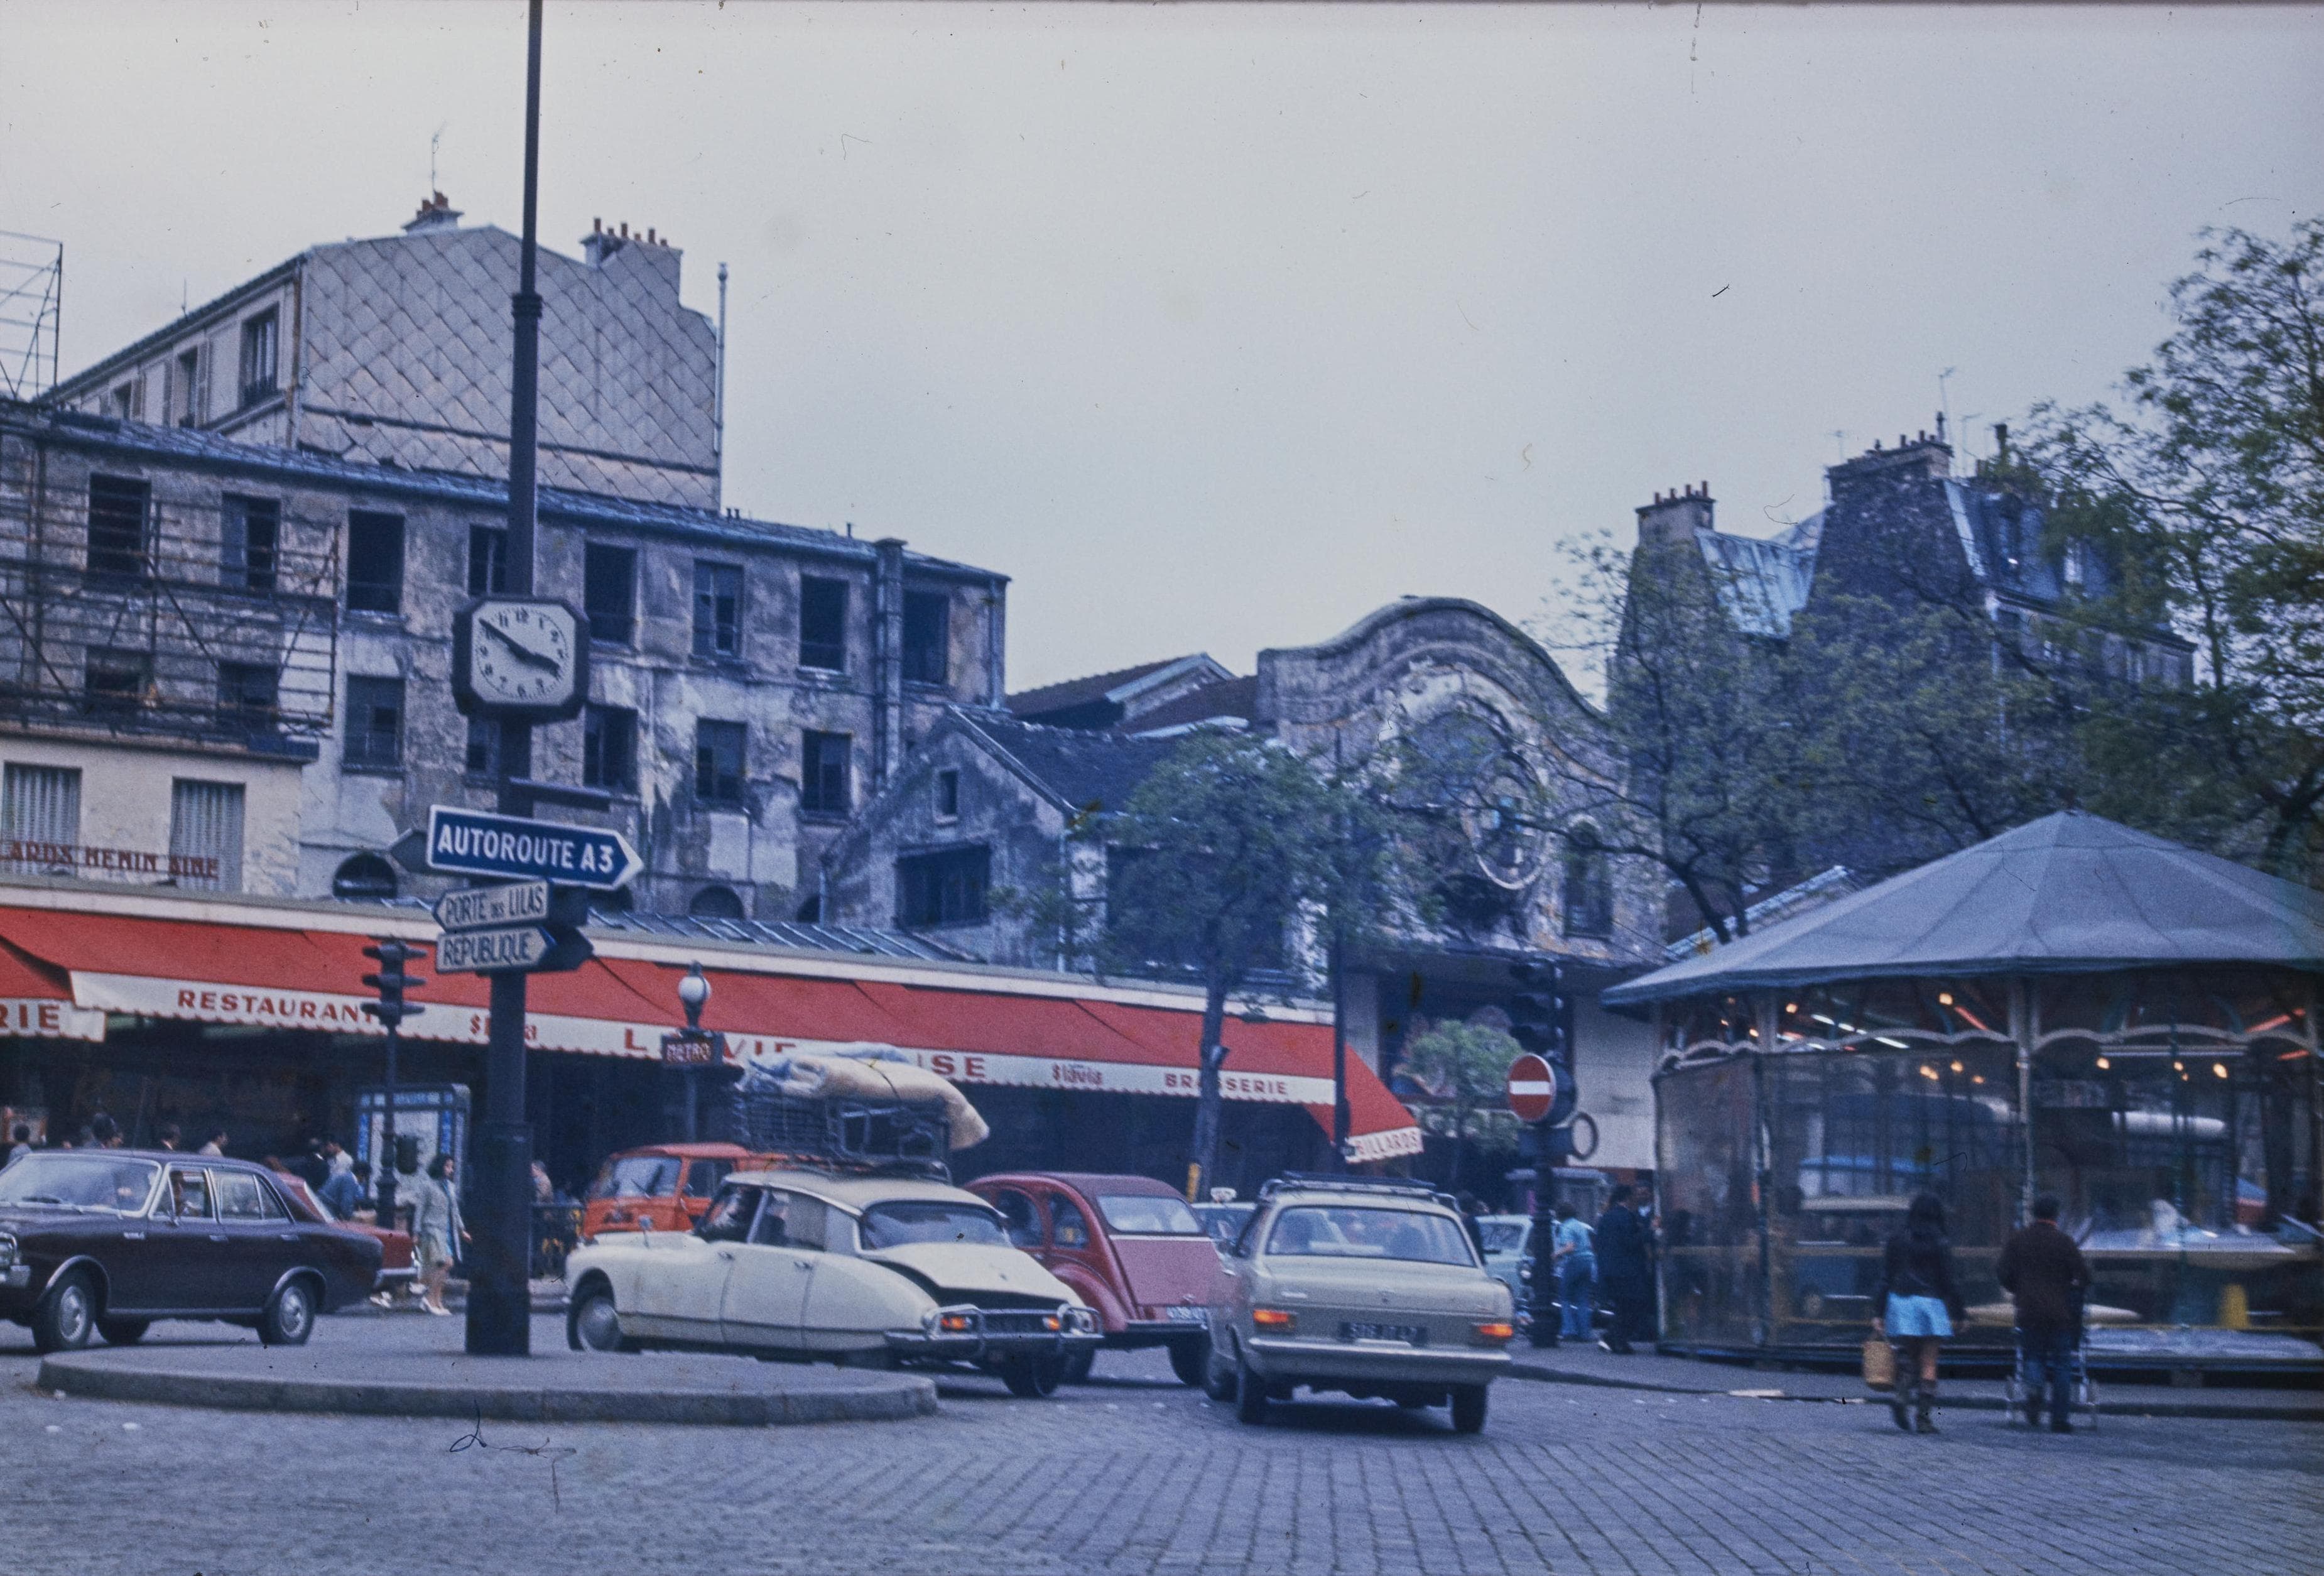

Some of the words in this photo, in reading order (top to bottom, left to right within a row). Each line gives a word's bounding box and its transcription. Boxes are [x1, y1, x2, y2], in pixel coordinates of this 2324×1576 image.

[438, 823, 574, 869] AUTOROUTE
[580, 843, 614, 874] A3
[445, 892, 487, 923] PORTE
[509, 884, 543, 916] LILAS
[1165, 1073, 1286, 1095] BRSERIE
